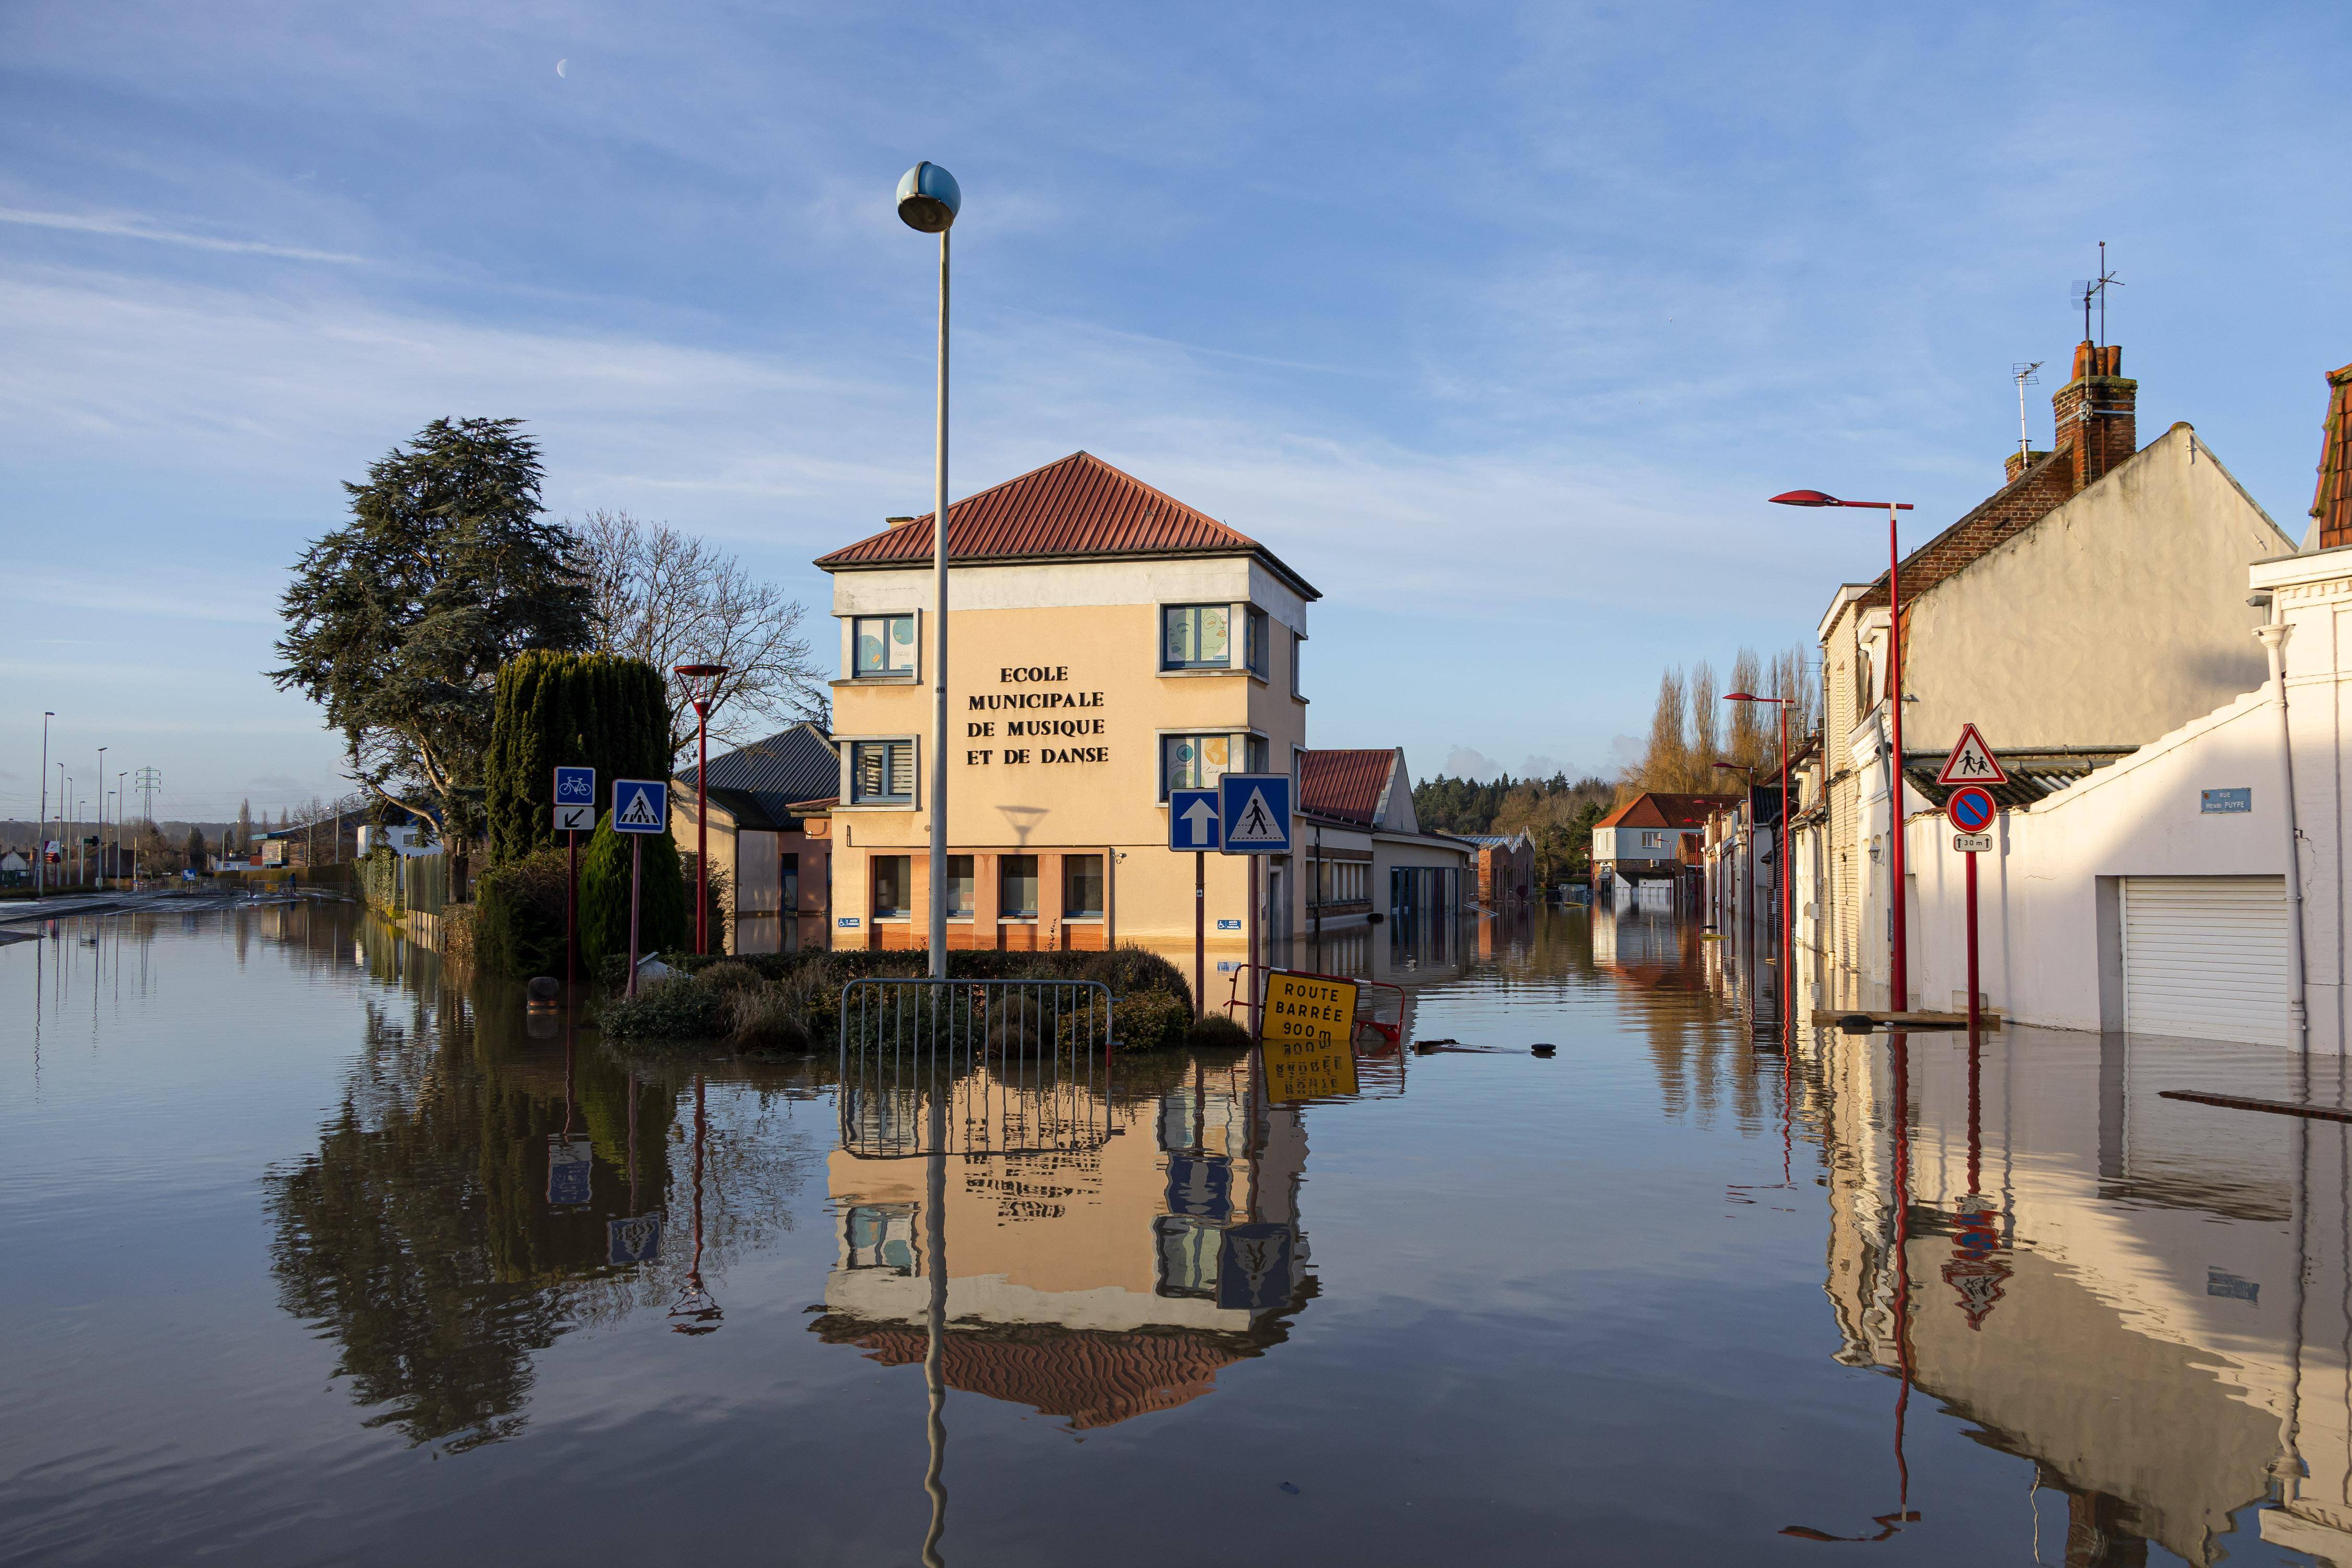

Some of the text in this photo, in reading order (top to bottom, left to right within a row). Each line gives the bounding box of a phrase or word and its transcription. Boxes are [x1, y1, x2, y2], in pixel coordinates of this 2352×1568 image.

[1000, 666, 1068, 683] ECOLE
[968, 692, 1104, 710] MUNICIPALE
[967, 719, 1105, 737] DE MUSIQUE
[966, 747, 1109, 765] ET DE DANSE
[1284, 983, 1339, 1002] ROUTE
[1275, 1001, 1343, 1022] BARRÉE
